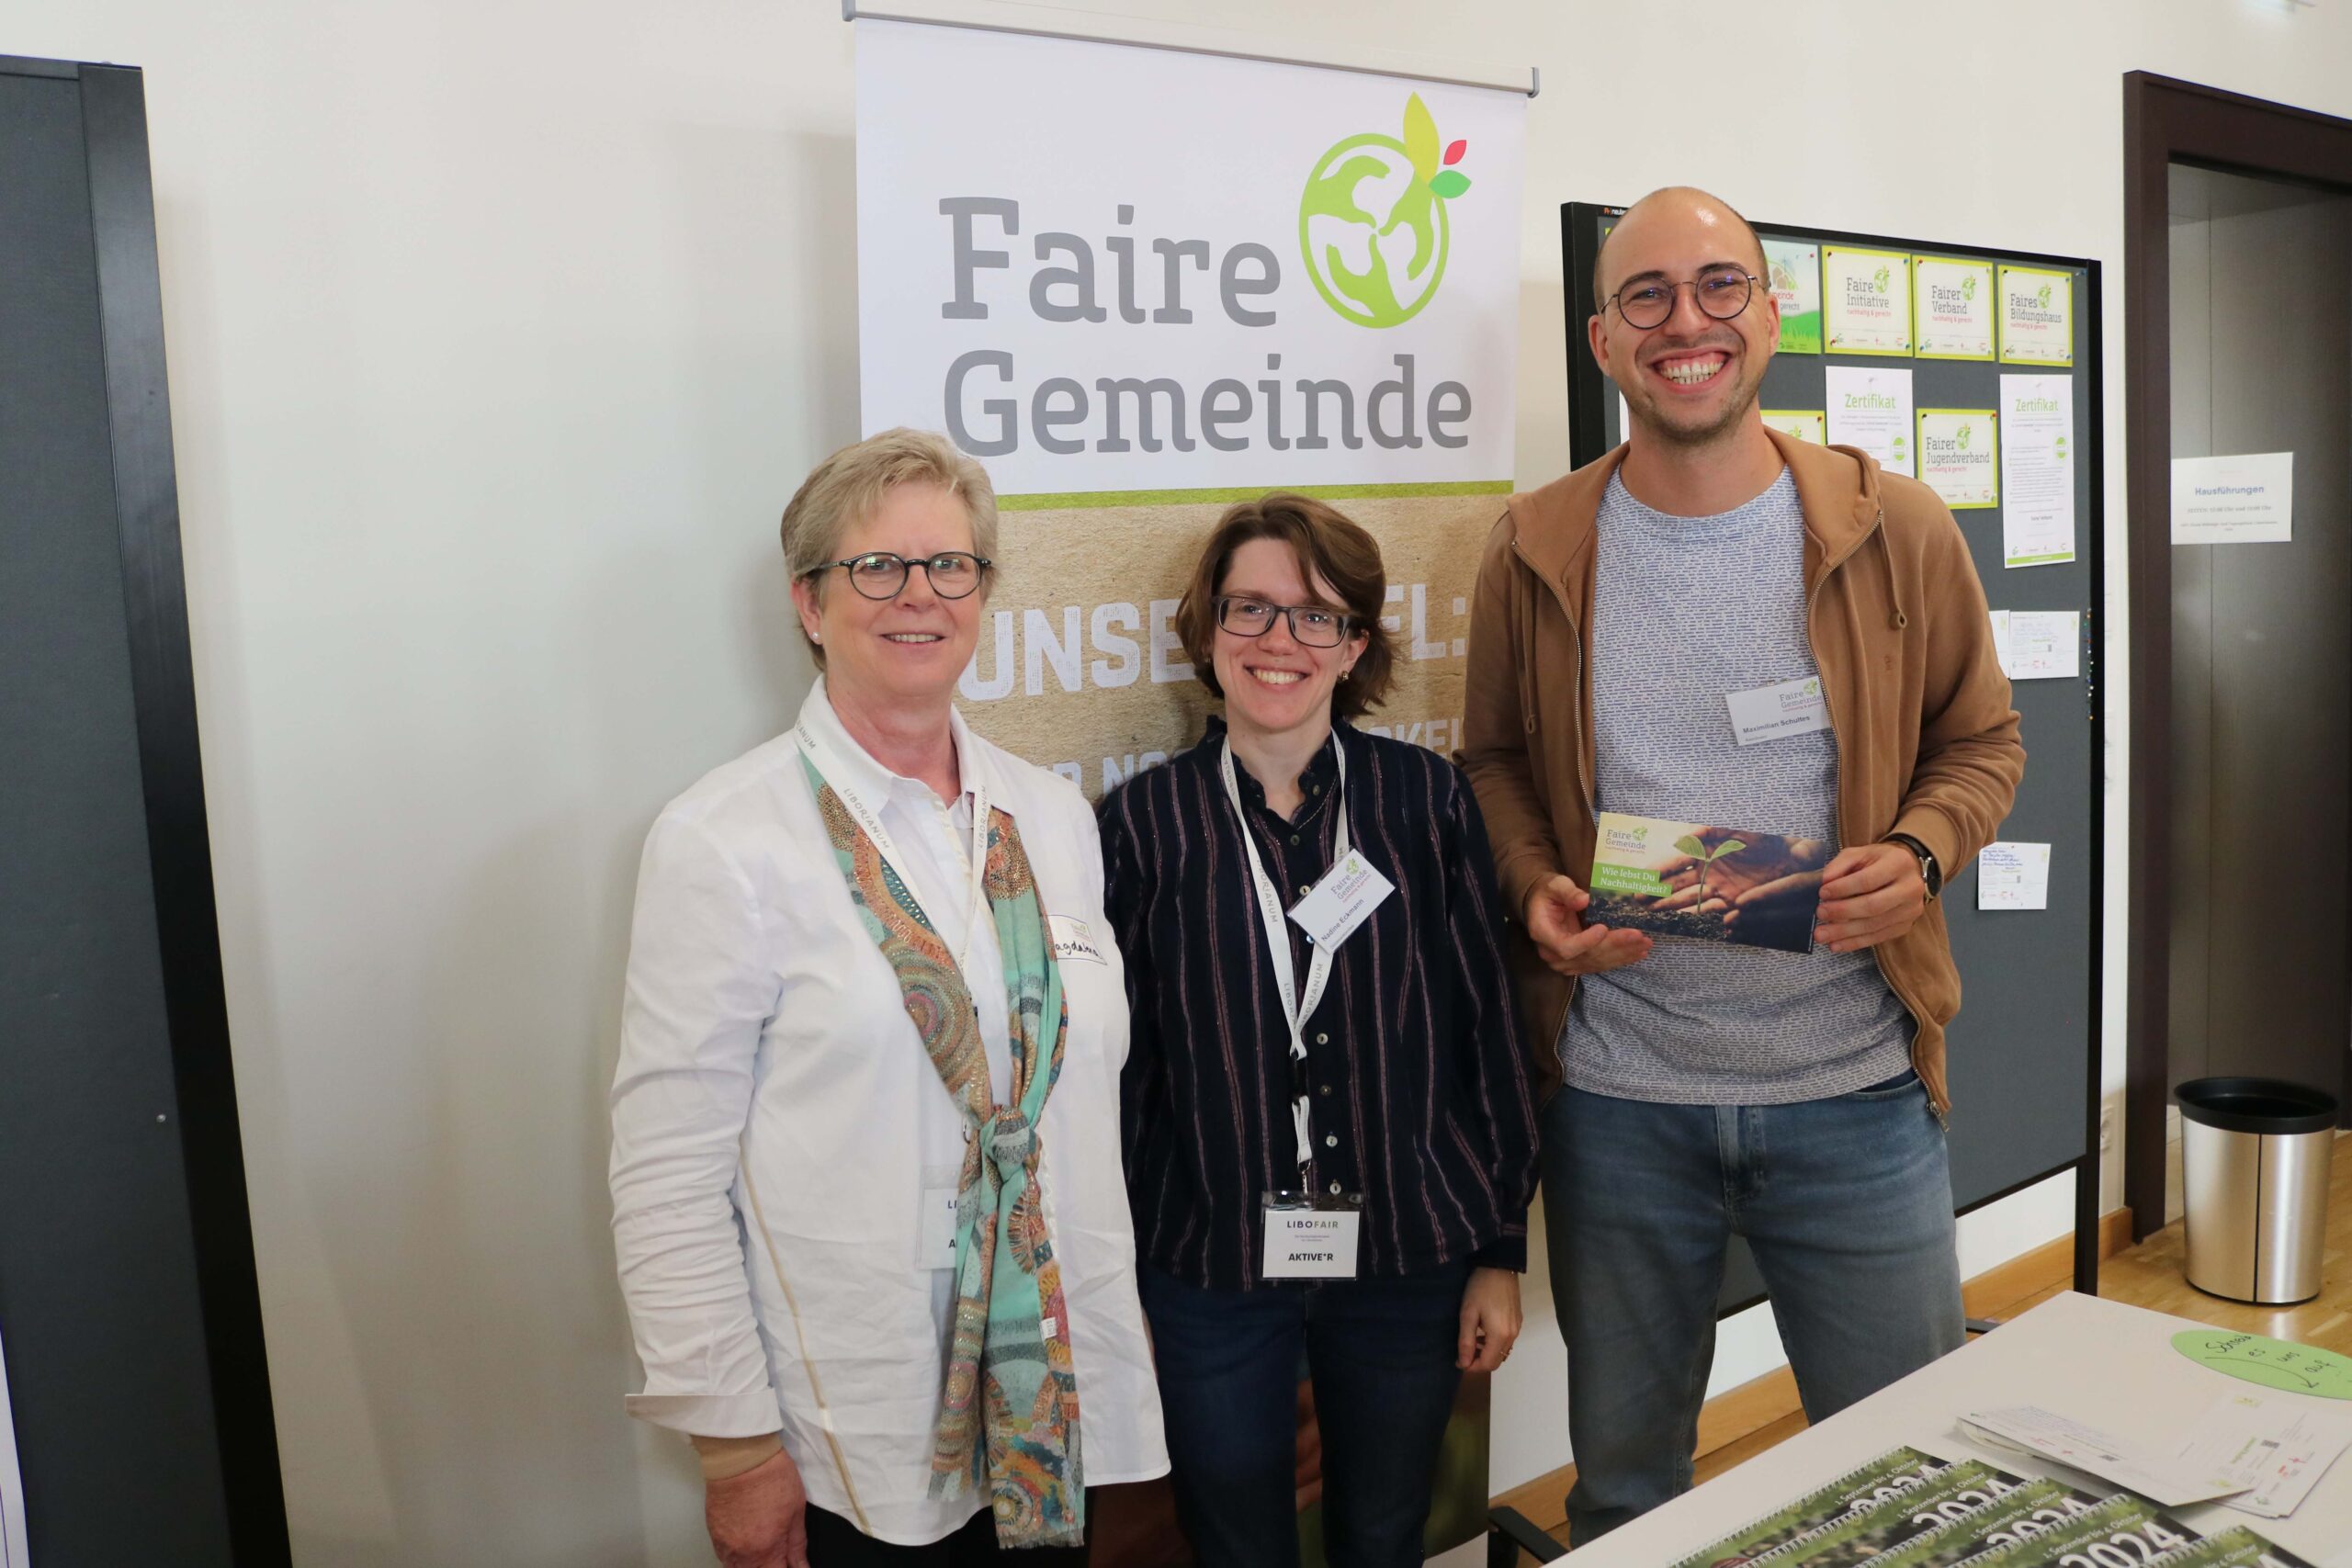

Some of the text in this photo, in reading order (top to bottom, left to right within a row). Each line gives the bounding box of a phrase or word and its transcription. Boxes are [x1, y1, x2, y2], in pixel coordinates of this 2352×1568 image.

[938, 197, 1281, 328] Faire
[1846, 277, 1873, 293] Faire
[1931, 285, 1962, 300] Fairer
[1846, 293, 1889, 309] Initiative
[1931, 300, 1967, 314] Verband
[2010, 293, 2038, 308] Faires
[2010, 308, 2062, 323] Bildungshaus
[944, 350, 1472, 457] Gemeinde
[1844, 393, 1896, 410] Zertifikat
[2015, 399, 2059, 412] Zertifikat
[1926, 436, 1956, 450] Fairer
[1926, 452, 1990, 467] Jugendverband
[2195, 485, 2264, 497] Hausführungen
[958, 598, 1196, 701] UNSE
[1779, 691, 1804, 702] Faire
[1781, 694, 1822, 709] Gemeinde
[1742, 716, 1811, 733] Maximilian Schultes
[843, 788, 889, 849] LIBORIANUM
[1607, 829, 1632, 840] Faire
[1605, 838, 1646, 850] Gemeinde
[1601, 866, 1656, 882] Wie lebst Du
[1330, 874, 1351, 895] Faire
[1337, 868, 1368, 899] Gemeinde
[1600, 877, 1668, 894] Nachhaltigkeit?
[1321, 922, 1341, 942] Nadine
[1339, 897, 1364, 923] Eckmann
[1286, 1221, 1339, 1229] LIBOFAIR
[1841, 1482, 1875, 1501] September
[1892, 1459, 1917, 1473] Oktober
[1904, 1495, 1938, 1516] September
[1957, 1472, 1984, 1488] Oktober
[1976, 1515, 2012, 1536] September
[2031, 1491, 2058, 1506] Oktober
[2051, 1533, 2089, 1556] September
[2111, 1511, 2141, 1529] Oktober
